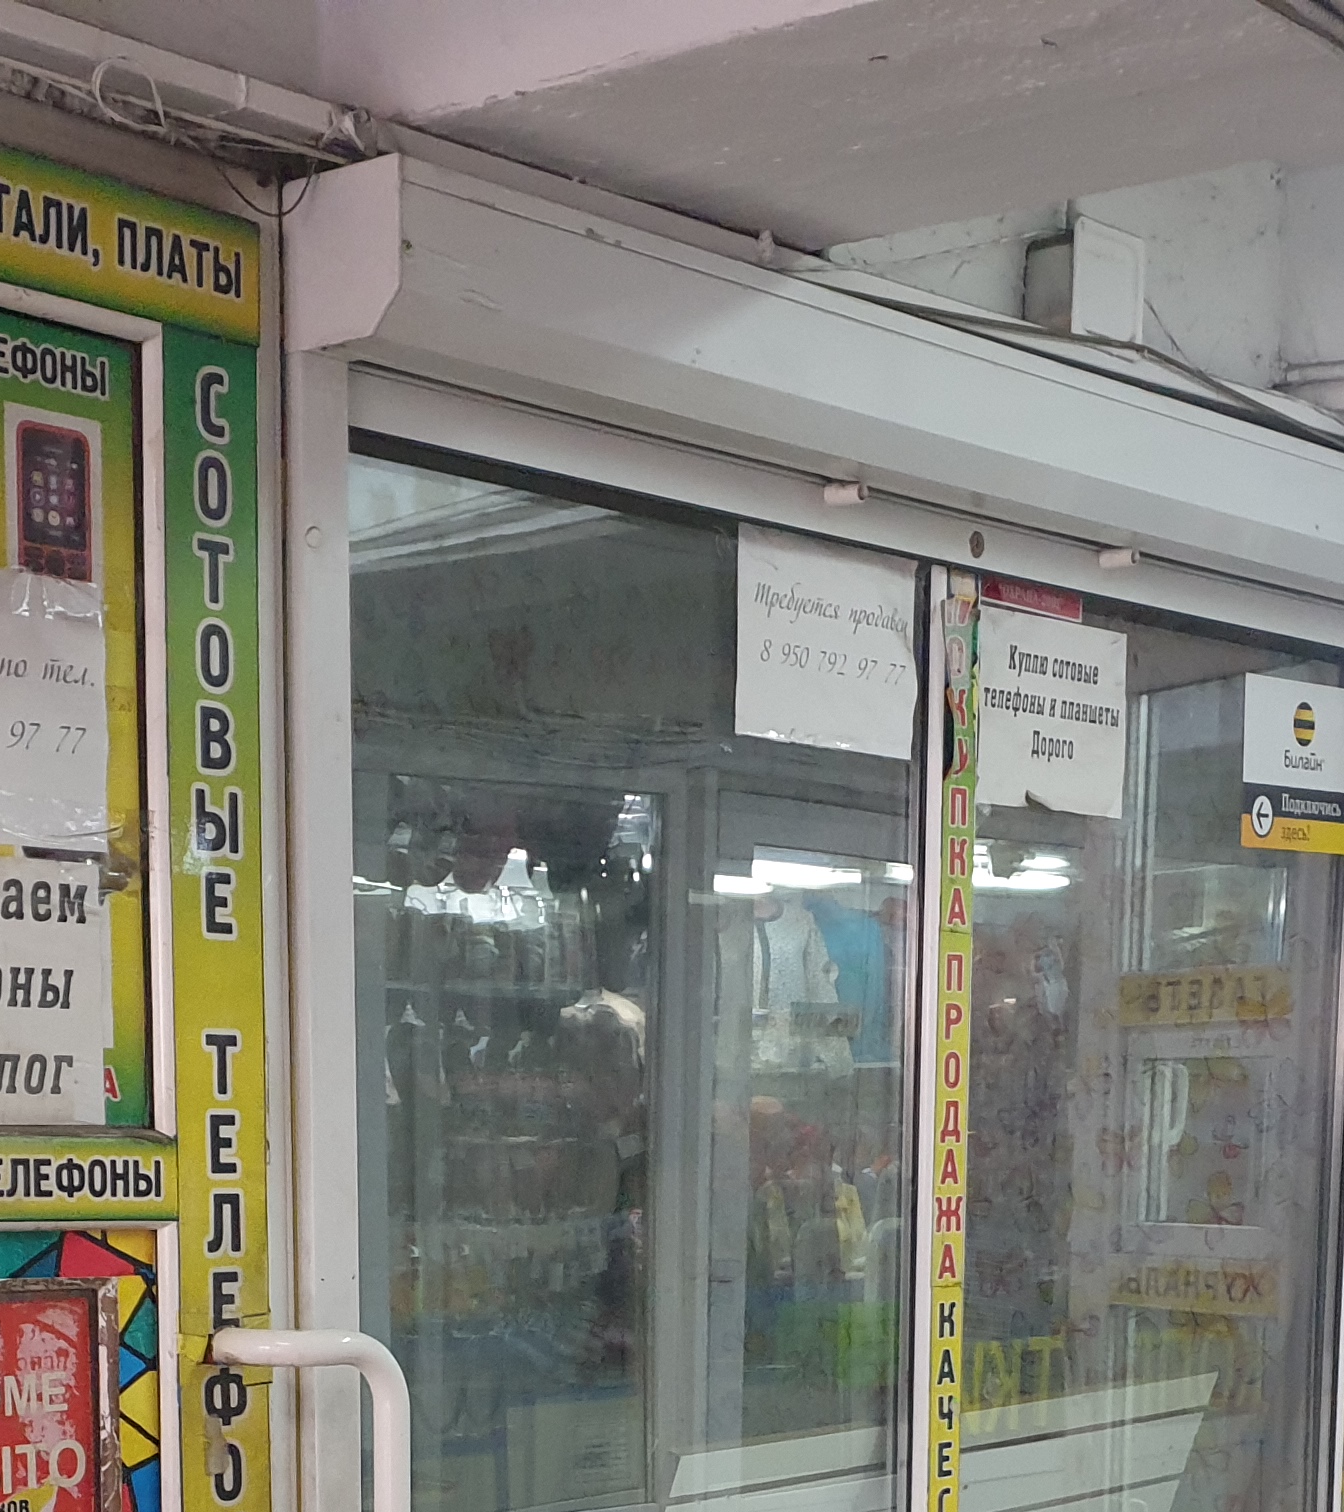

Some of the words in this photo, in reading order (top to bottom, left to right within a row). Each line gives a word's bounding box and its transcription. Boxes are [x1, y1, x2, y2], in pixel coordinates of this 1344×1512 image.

[116, 221, 242, 299] ПЛАТЫ
[754, 582, 840, 623] Требуется
[41, 659, 95, 688] тел.
[195, 372, 239, 935] СОТОВЫЕ
[760, 639, 772, 662] 8
[781, 643, 809, 668] 950
[818, 650, 847, 676] 792
[856, 657, 878, 680] 97
[884, 663, 906, 685] 77
[1009, 644, 1048, 677] Куплю
[1052, 658, 1099, 685] сотовые
[983, 686, 1044, 717] телефоны
[1048, 699, 1057, 716] и
[1060, 699, 1120, 728] планшеты
[6, 720, 41, 750] 97
[56, 725, 86, 754] 77
[1031, 730, 1074, 762] Дорого
[1281, 793, 1341, 817] Подключись
[1281, 824, 1310, 842] здесь!
[935, 953, 965, 1280] ПРОДАЖА
